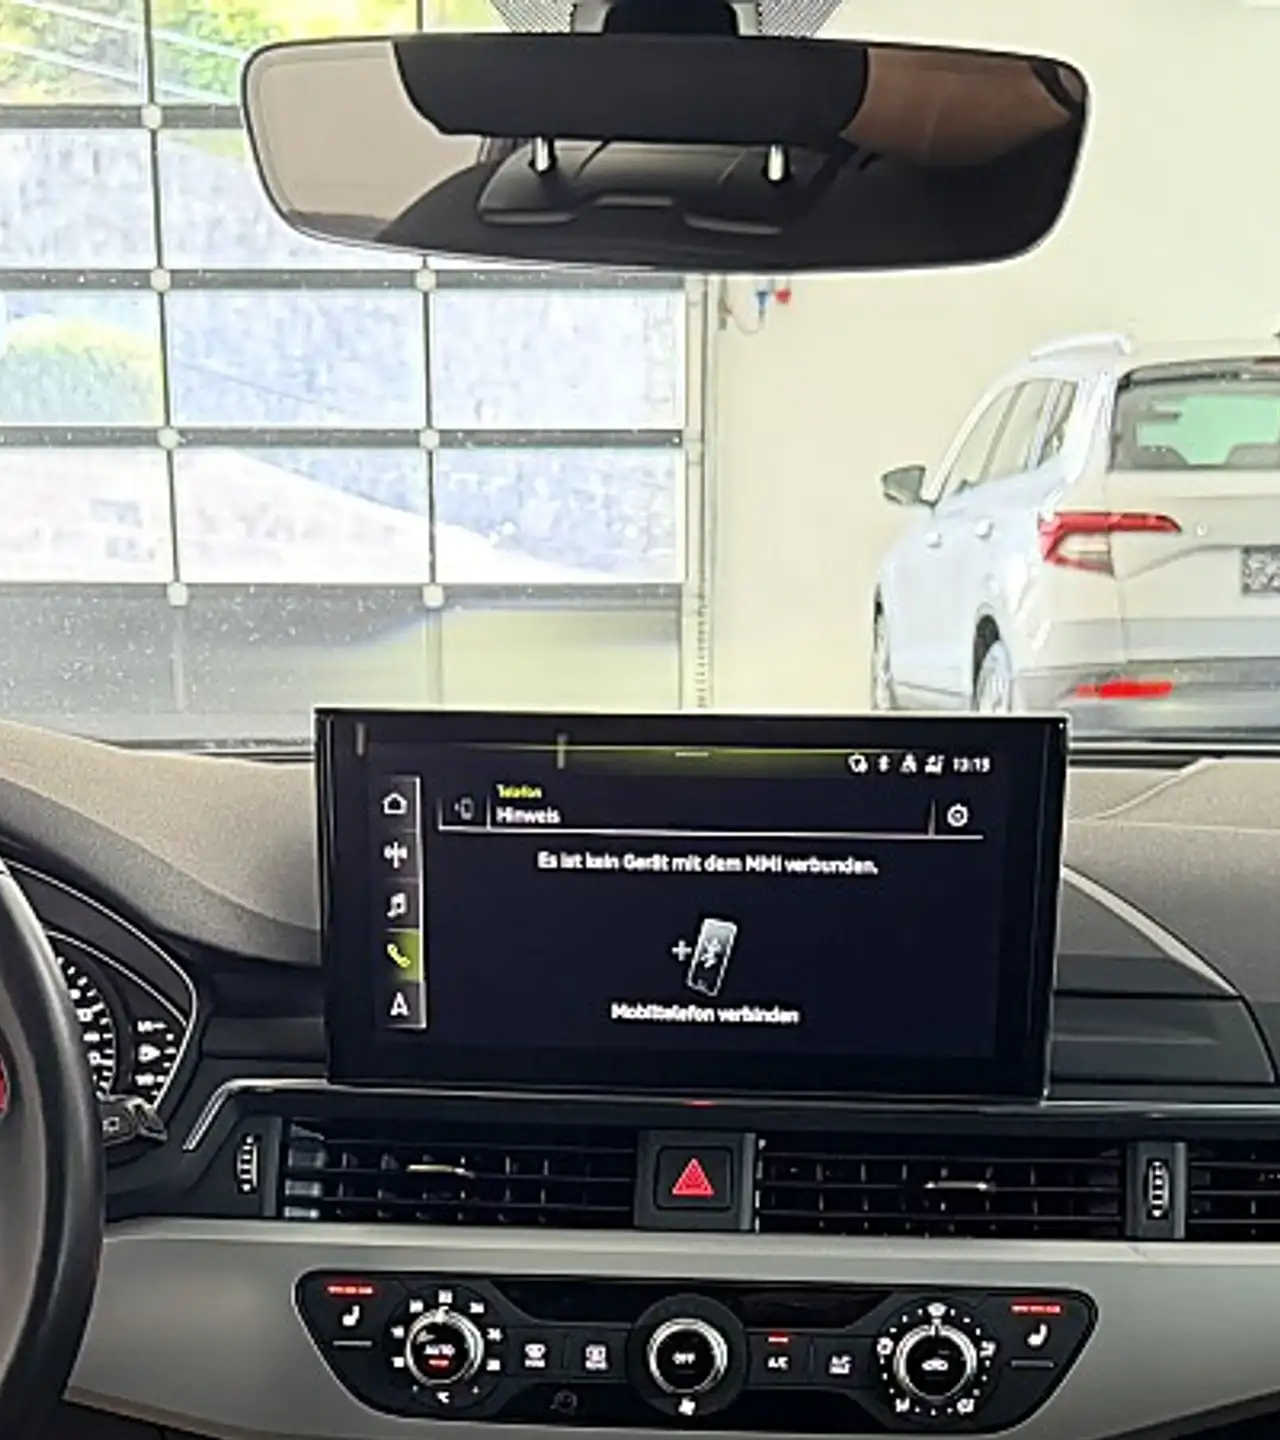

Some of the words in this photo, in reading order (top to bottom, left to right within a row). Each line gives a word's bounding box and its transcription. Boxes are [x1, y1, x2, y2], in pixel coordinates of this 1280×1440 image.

[496, 806, 561, 823] Hinweis
[538, 852, 558, 869] Es
[560, 852, 583, 869] ist
[586, 852, 620, 869] kein
[623, 852, 670, 871] Gerät
[672, 854, 702, 871] mit
[704, 855, 742, 872] dem
[745, 855, 782, 873] MMI
[784, 856, 878, 875] verbunden.
[611, 1002, 715, 1022] Mobiltelefon
[717, 1005, 800, 1025] verbinden
